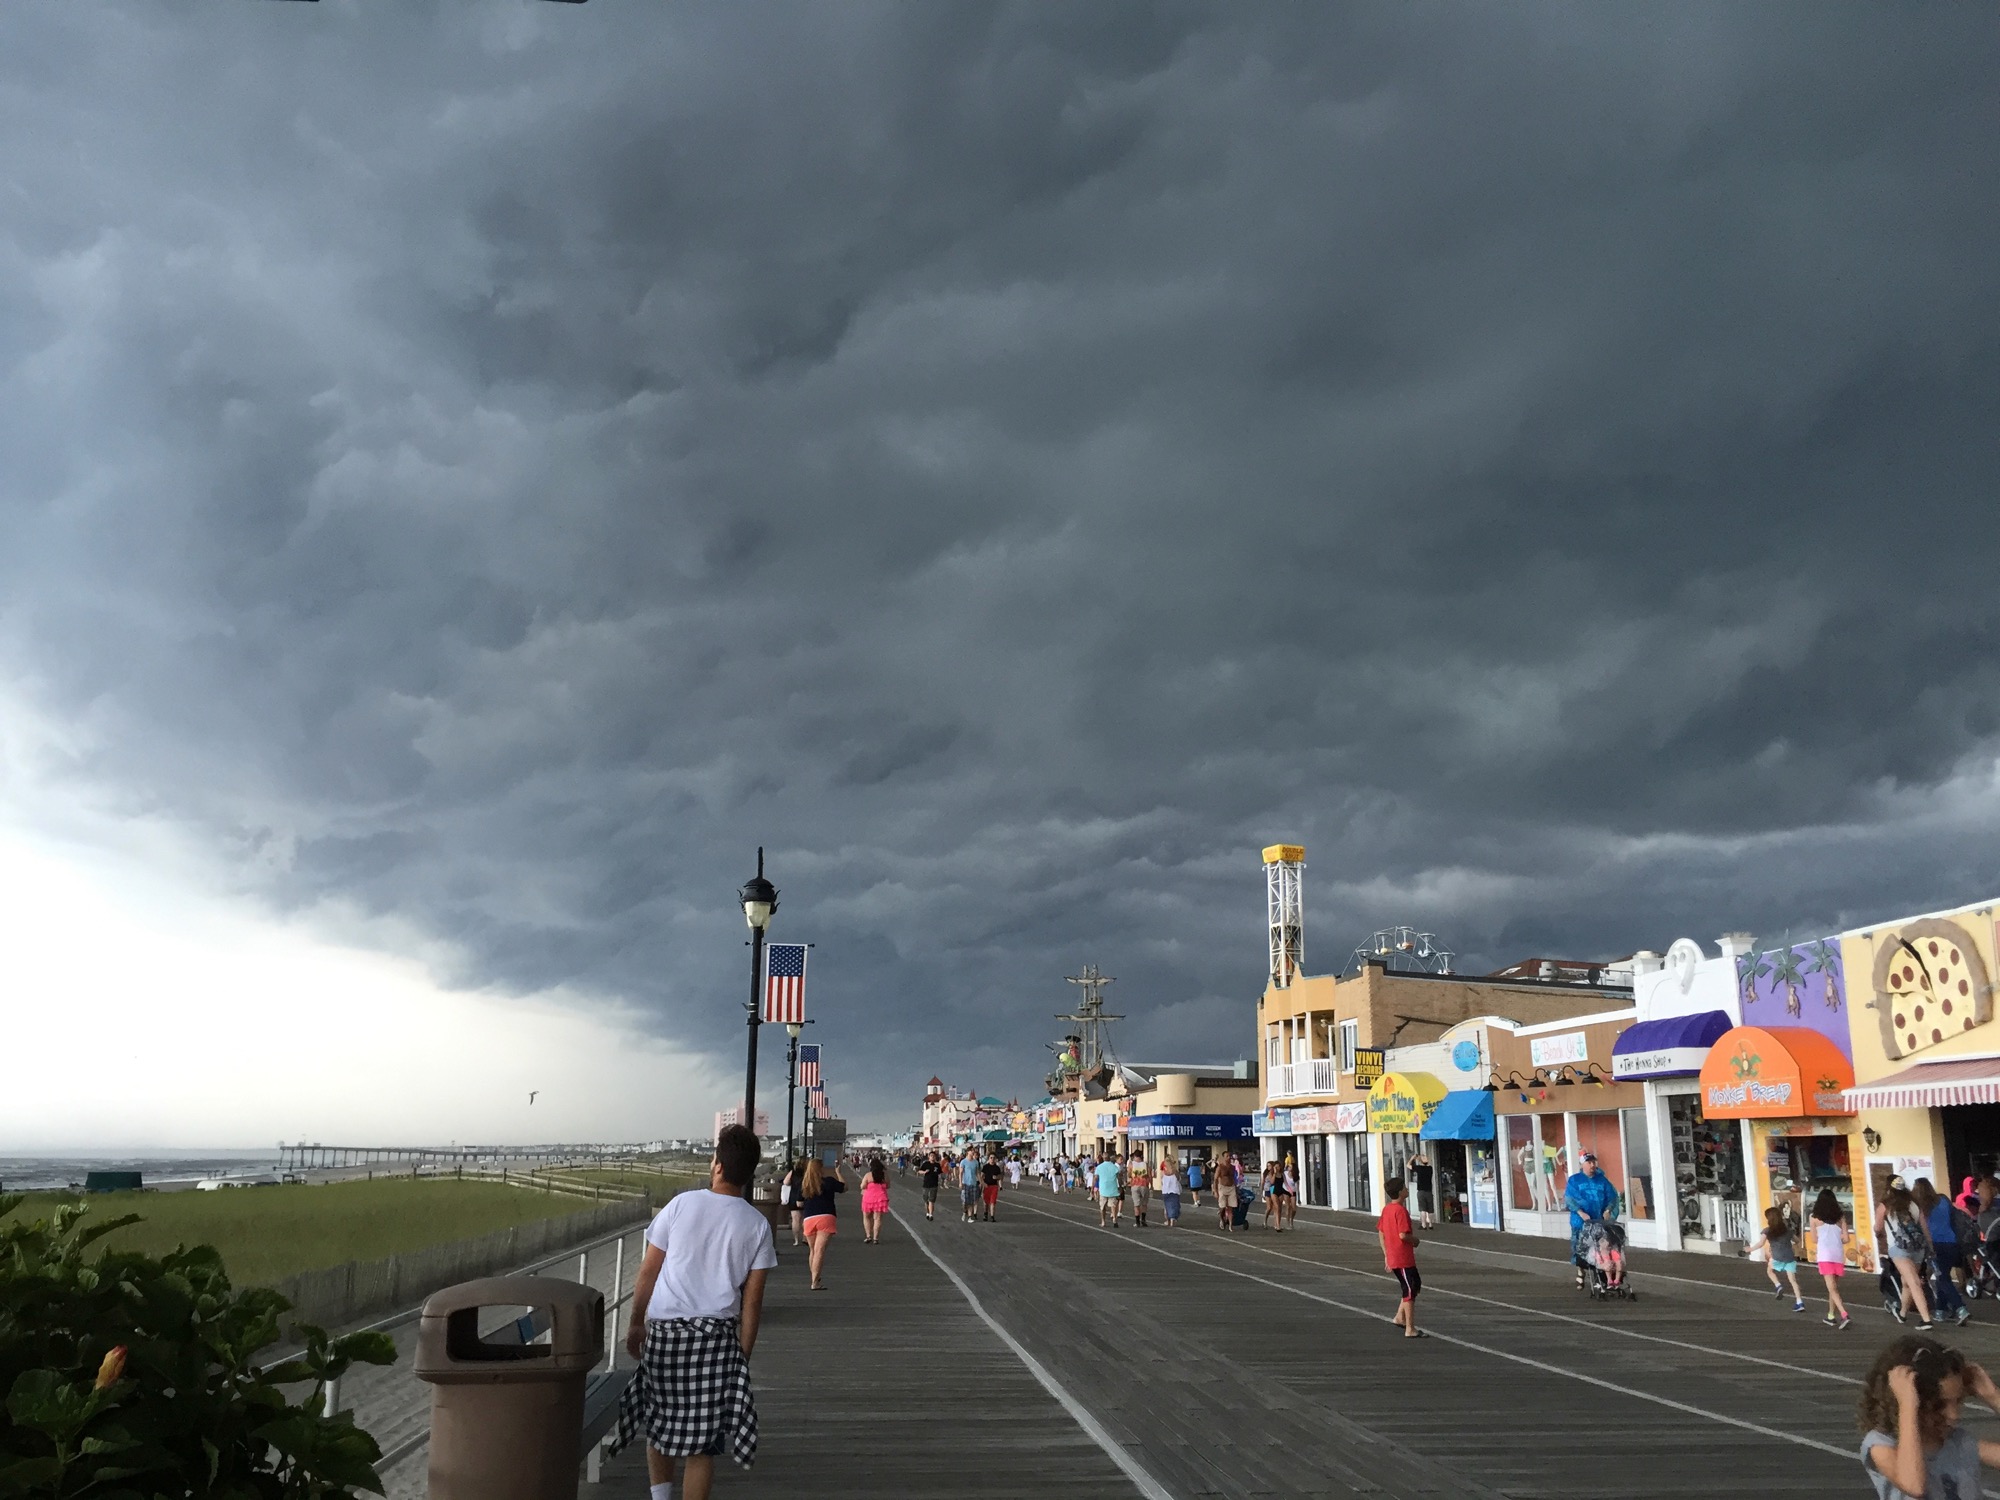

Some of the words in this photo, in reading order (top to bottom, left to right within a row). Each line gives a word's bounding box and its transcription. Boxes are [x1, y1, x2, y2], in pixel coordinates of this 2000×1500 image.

[1356, 1052, 1383, 1065] VINYL
[1356, 1066, 1383, 1075] RECORDS
[1708, 1080, 1750, 1108] MONKEY
[1750, 1081, 1792, 1106] BREAD
[1155, 1126, 1175, 1136] WATER
[1176, 1126, 1194, 1136] TAFFY
